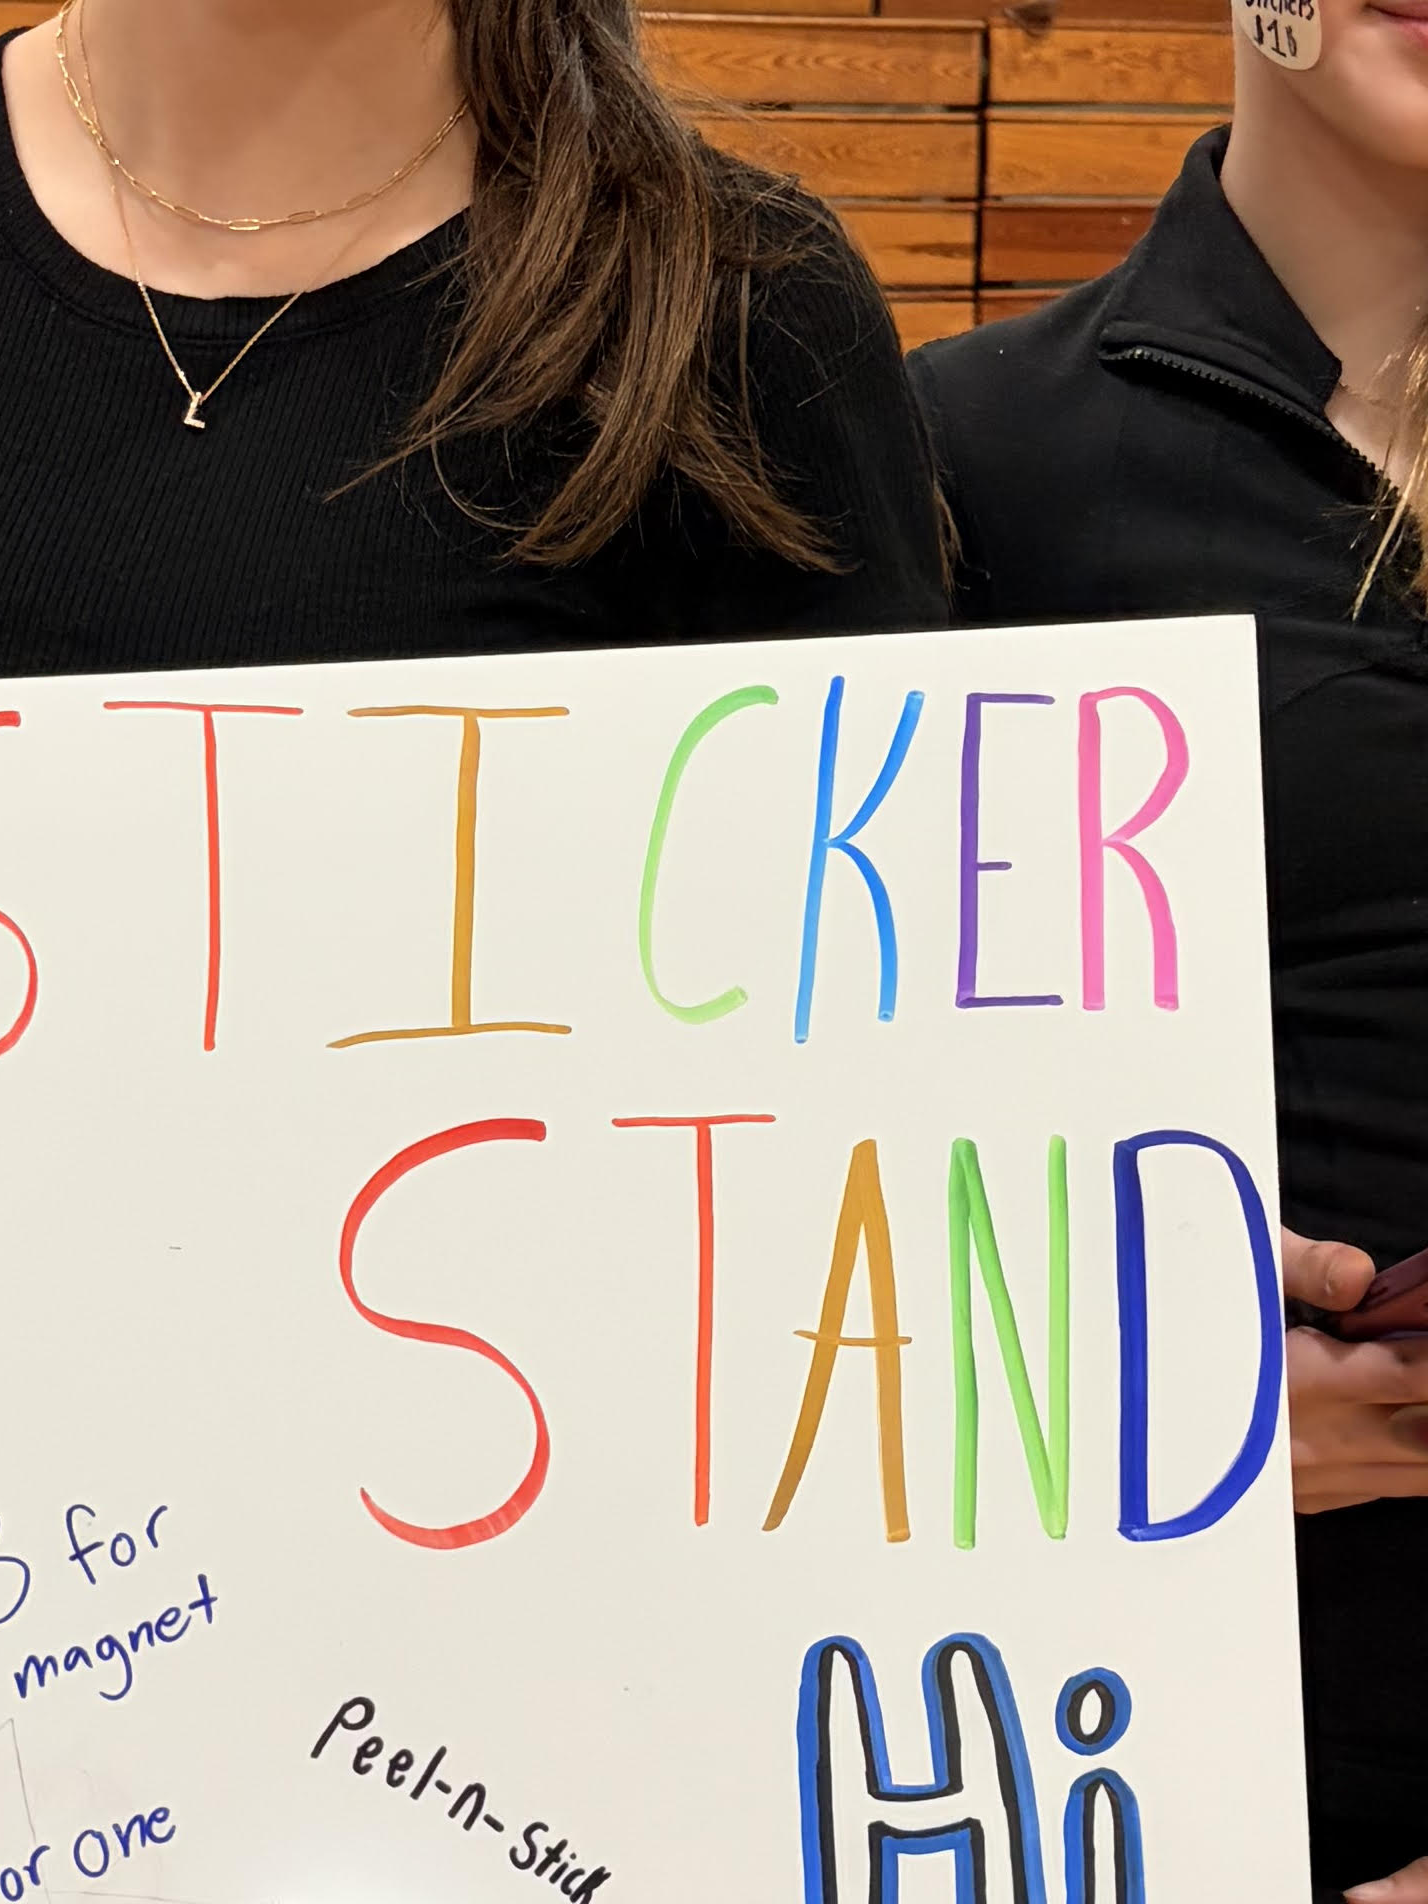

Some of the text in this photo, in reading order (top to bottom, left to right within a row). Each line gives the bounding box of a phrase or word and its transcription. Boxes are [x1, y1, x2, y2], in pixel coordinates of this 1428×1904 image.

[338, 1112, 1283, 1550] STAND
[66, 1504, 169, 1584] for
[13, 1574, 218, 1700] magnet
[73, 1805, 178, 1879] one
